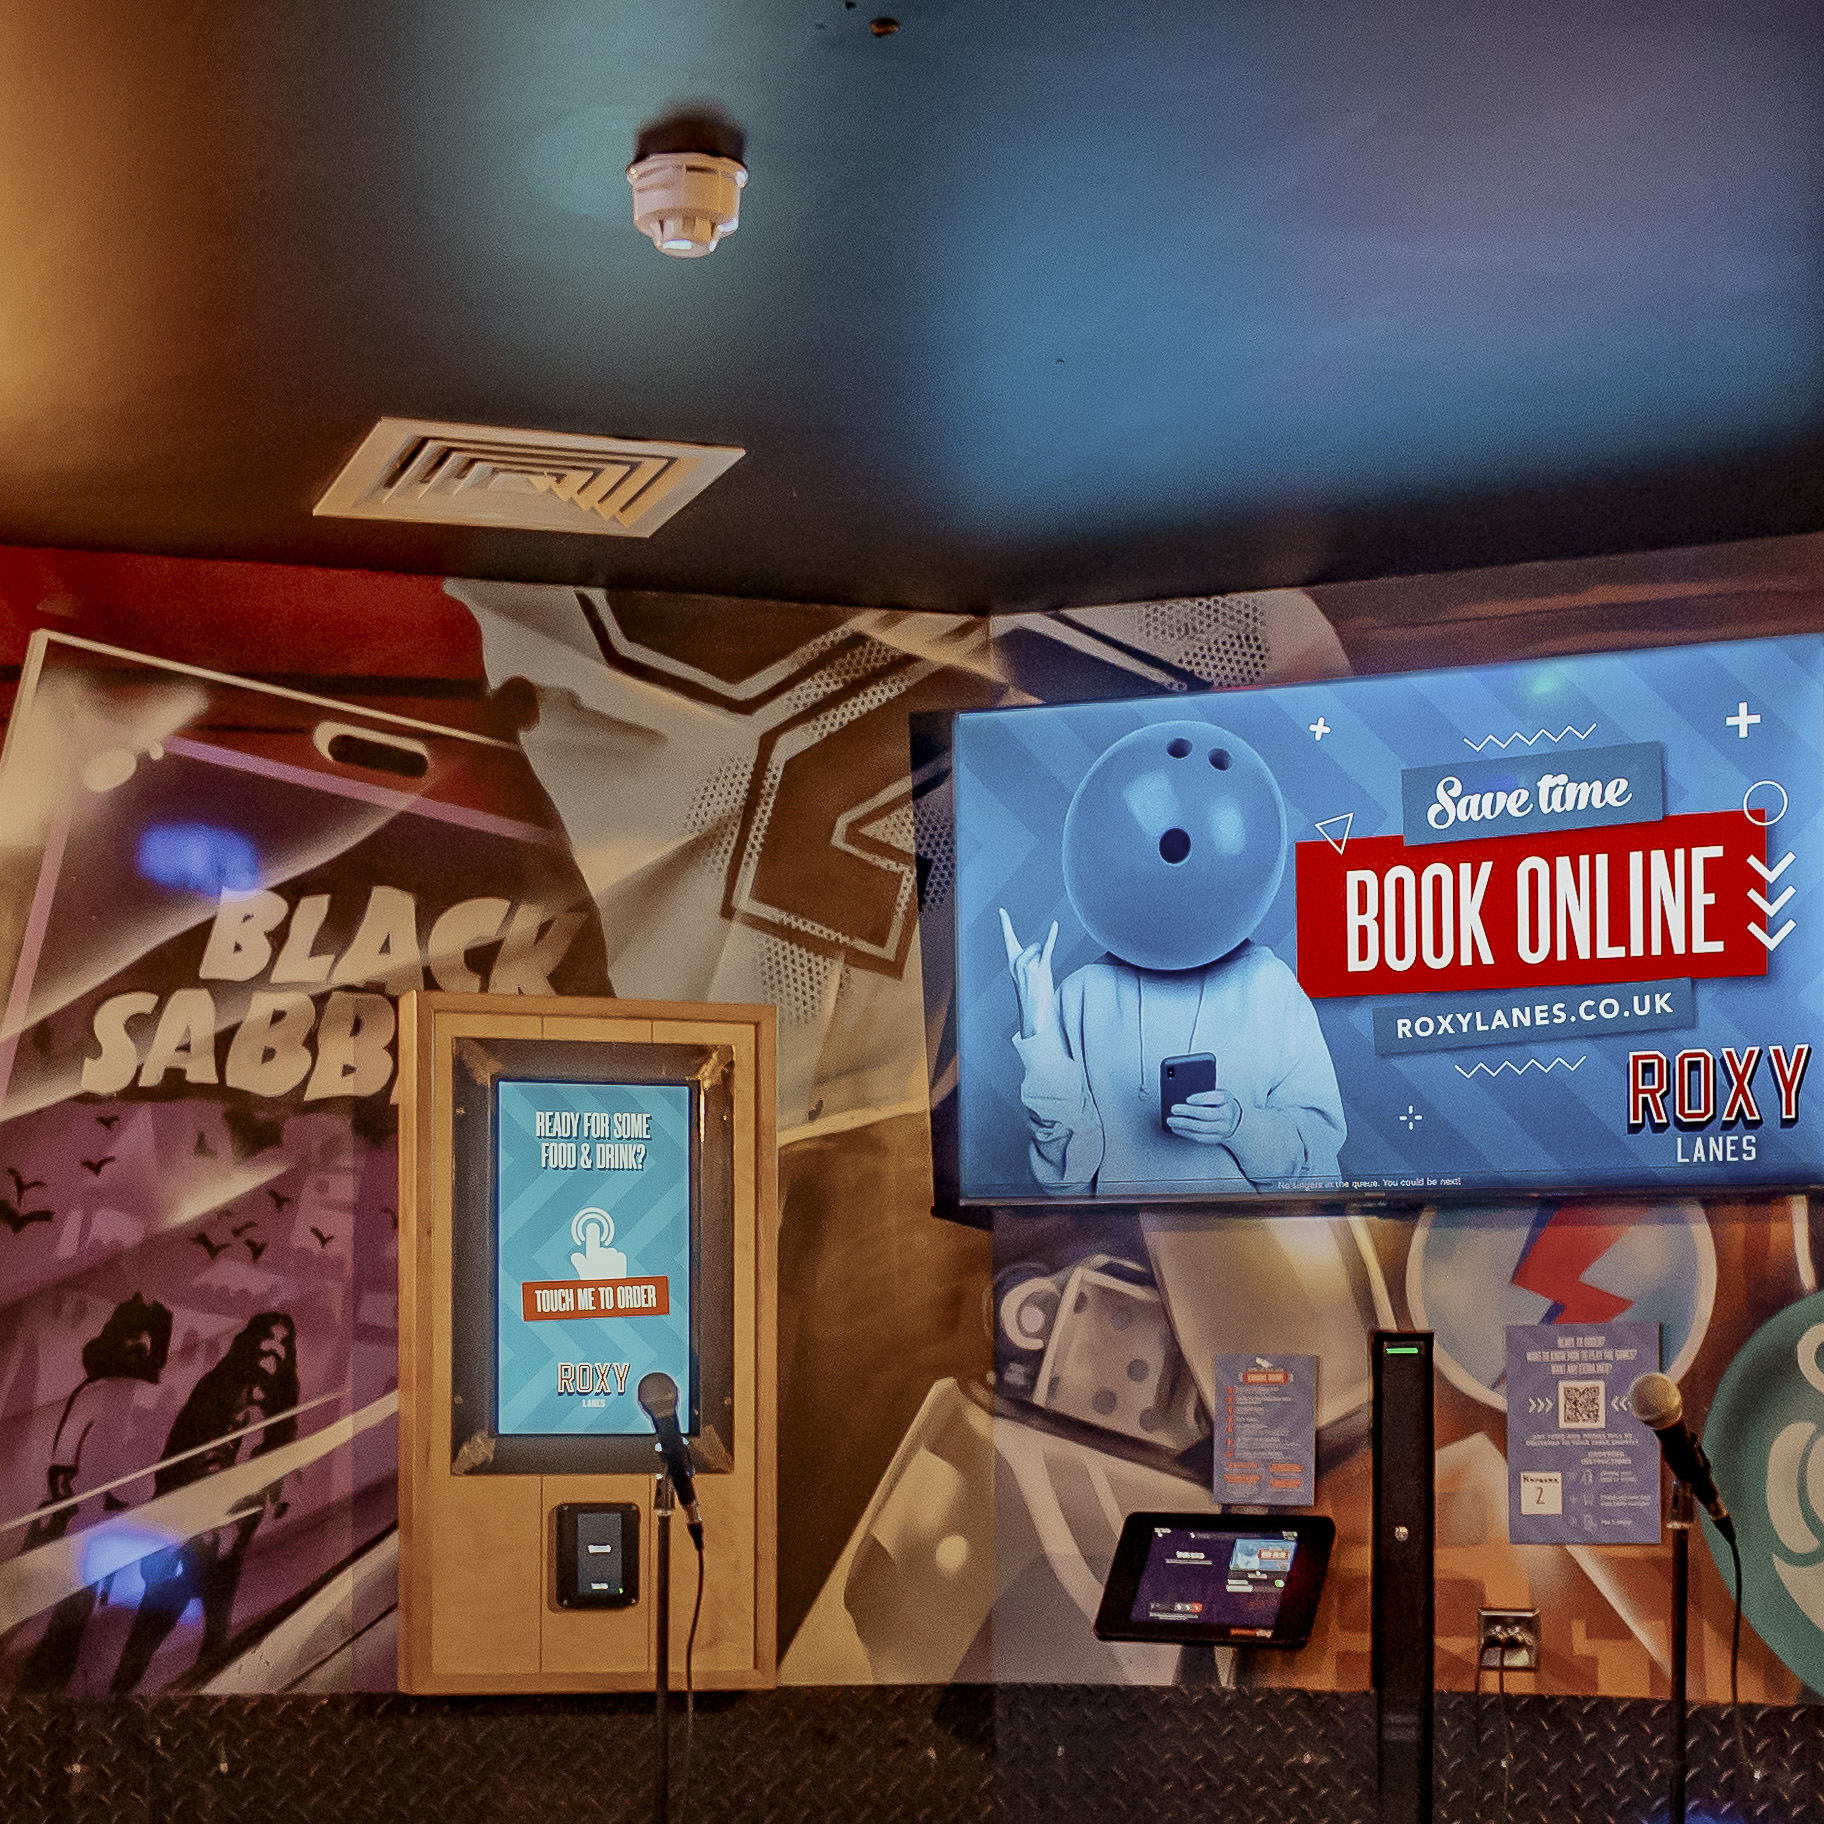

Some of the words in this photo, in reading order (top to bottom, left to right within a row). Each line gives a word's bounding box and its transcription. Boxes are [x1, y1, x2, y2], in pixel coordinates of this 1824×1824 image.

[1427, 776, 1533, 830] Save
[1533, 773, 1633, 815] time
[1346, 861, 1494, 973] BOOK
[1516, 845, 1725, 965] ONLINE
[199, 886, 588, 995] BLACK
[1396, 992, 1674, 1038] ROXYLANES.CO.UK
[81, 989, 398, 1105] SABB
[1627, 1044, 1810, 1133] ROXY
[536, 1111, 580, 1138] READY
[583, 1112, 610, 1139] FOR
[613, 1112, 651, 1140] SOME
[541, 1142, 577, 1170] FOOD
[580, 1142, 593, 1170] &
[596, 1143, 647, 1171] DRINK?
[1677, 1135, 1756, 1163] LANES
[1383, 1177, 1398, 1188] You
[1400, 1176, 1424, 1187] could
[1427, 1176, 1437, 1186] be
[535, 1288, 575, 1312] TOUCH
[577, 1287, 596, 1310] ME
[598, 1286, 614, 1309] TO
[616, 1285, 657, 1309] ORDER
[557, 1361, 630, 1396] ROXY
[1536, 1486, 1546, 1505] 2
